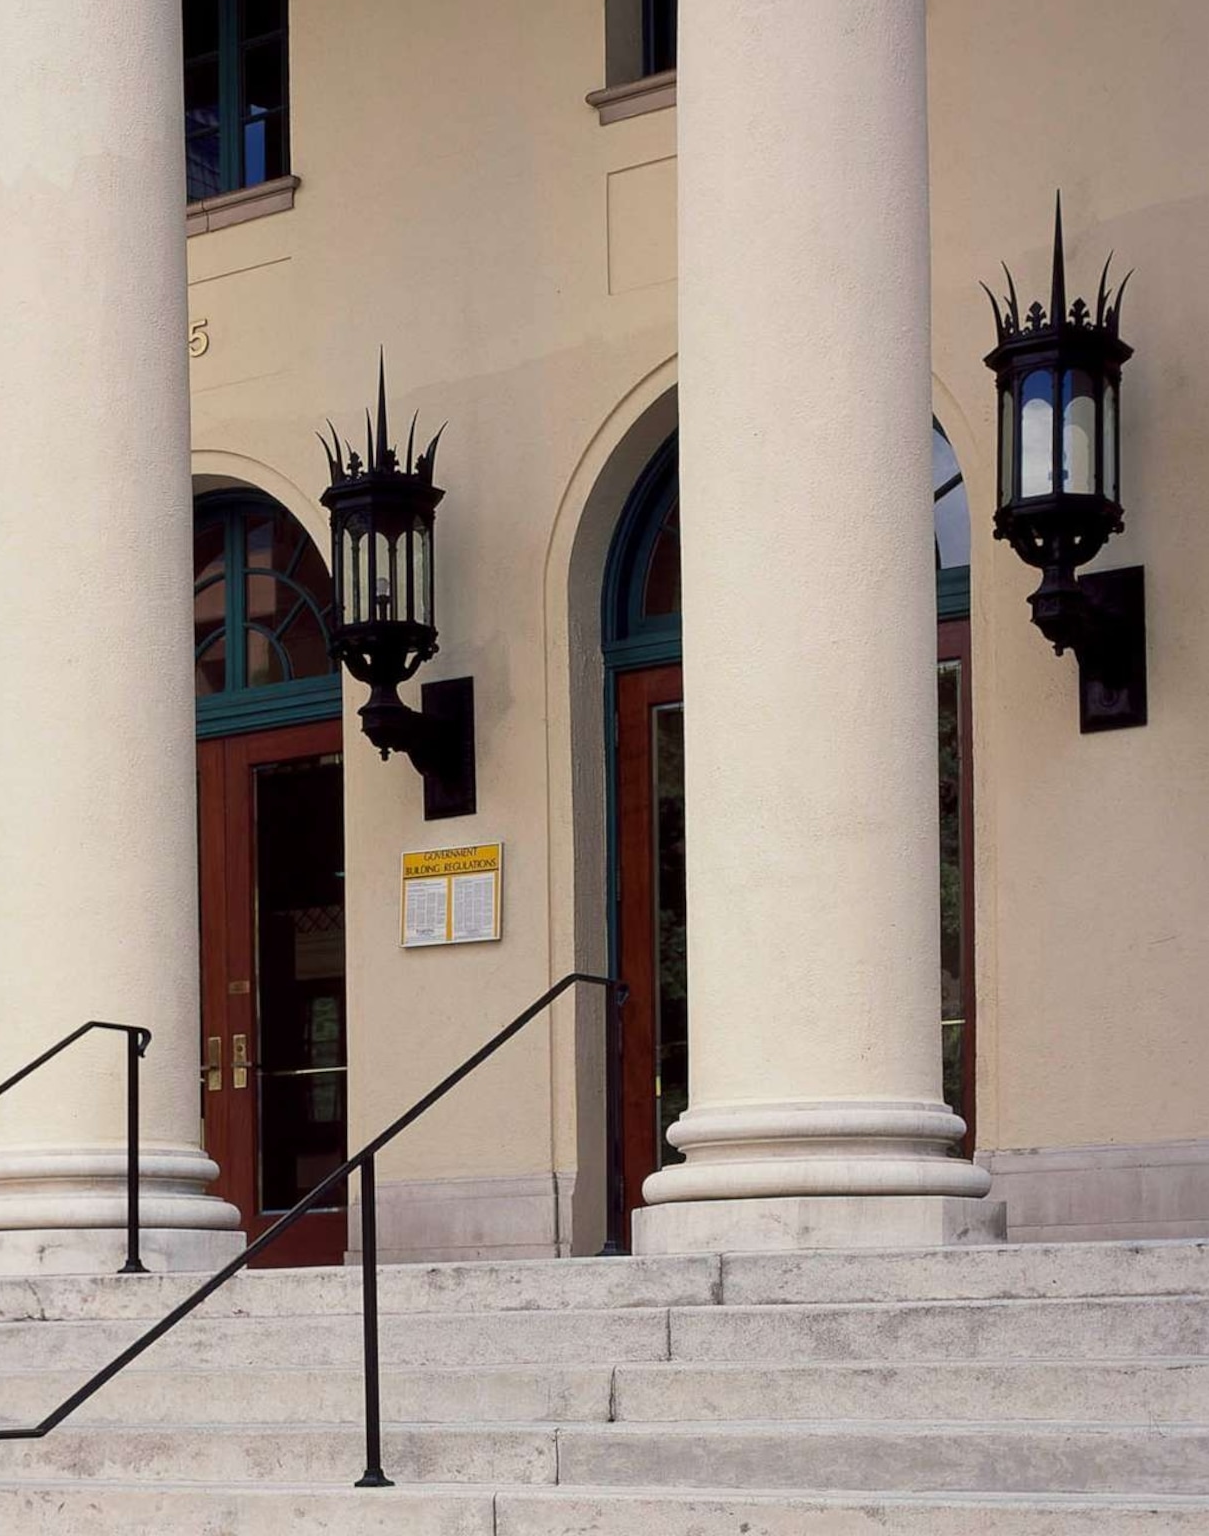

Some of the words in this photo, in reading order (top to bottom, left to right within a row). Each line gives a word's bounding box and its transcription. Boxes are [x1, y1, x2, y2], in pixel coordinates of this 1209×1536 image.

[423, 846, 479, 861] GOVERNMENT
[405, 864, 440, 875] BUILDING
[444, 858, 497, 871] REGULATIONS
